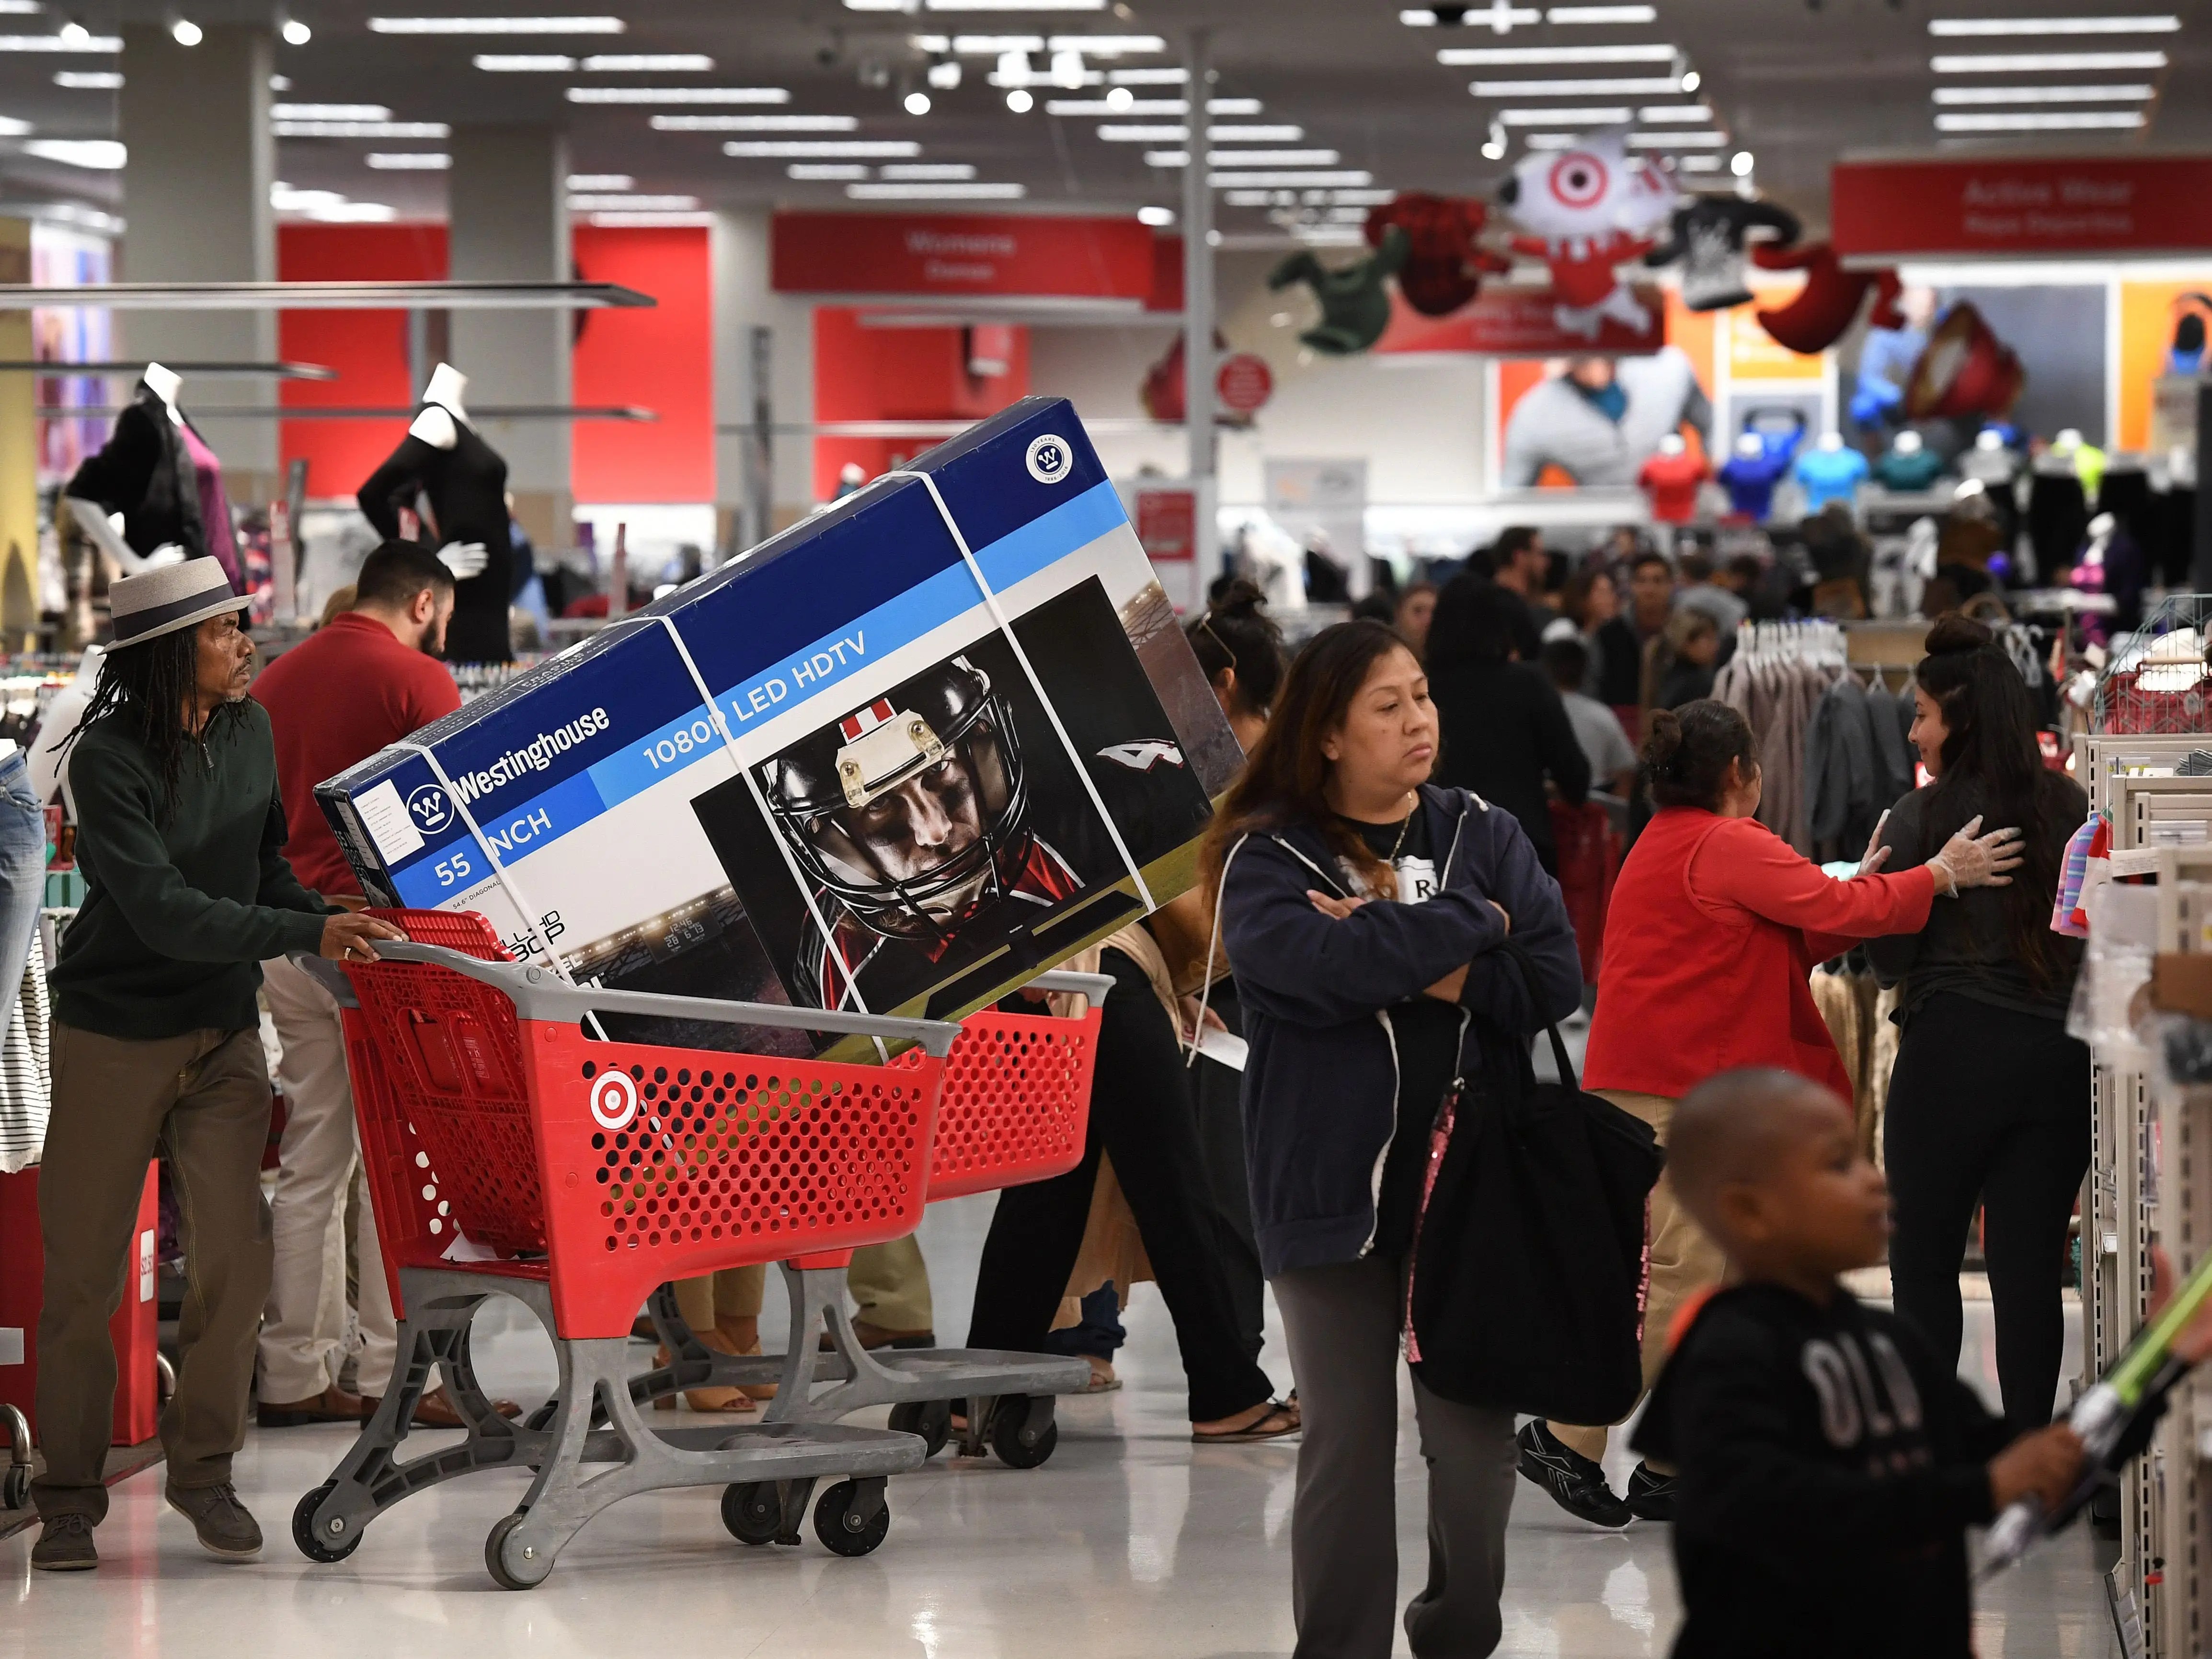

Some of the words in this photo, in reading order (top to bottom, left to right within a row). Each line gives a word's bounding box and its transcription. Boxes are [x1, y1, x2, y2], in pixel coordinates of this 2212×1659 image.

[643, 710, 726, 769] 1080P
[732, 678, 787, 721] LED
[791, 630, 864, 688] HDTV
[452, 707, 609, 804] Westinghouse
[435, 852, 470, 886] 55
[485, 808, 552, 858] NCH
[453, 897, 467, 909] 54.6"
[469, 881, 501, 901] DIAGONAL
[684, 930, 692, 939] 6
